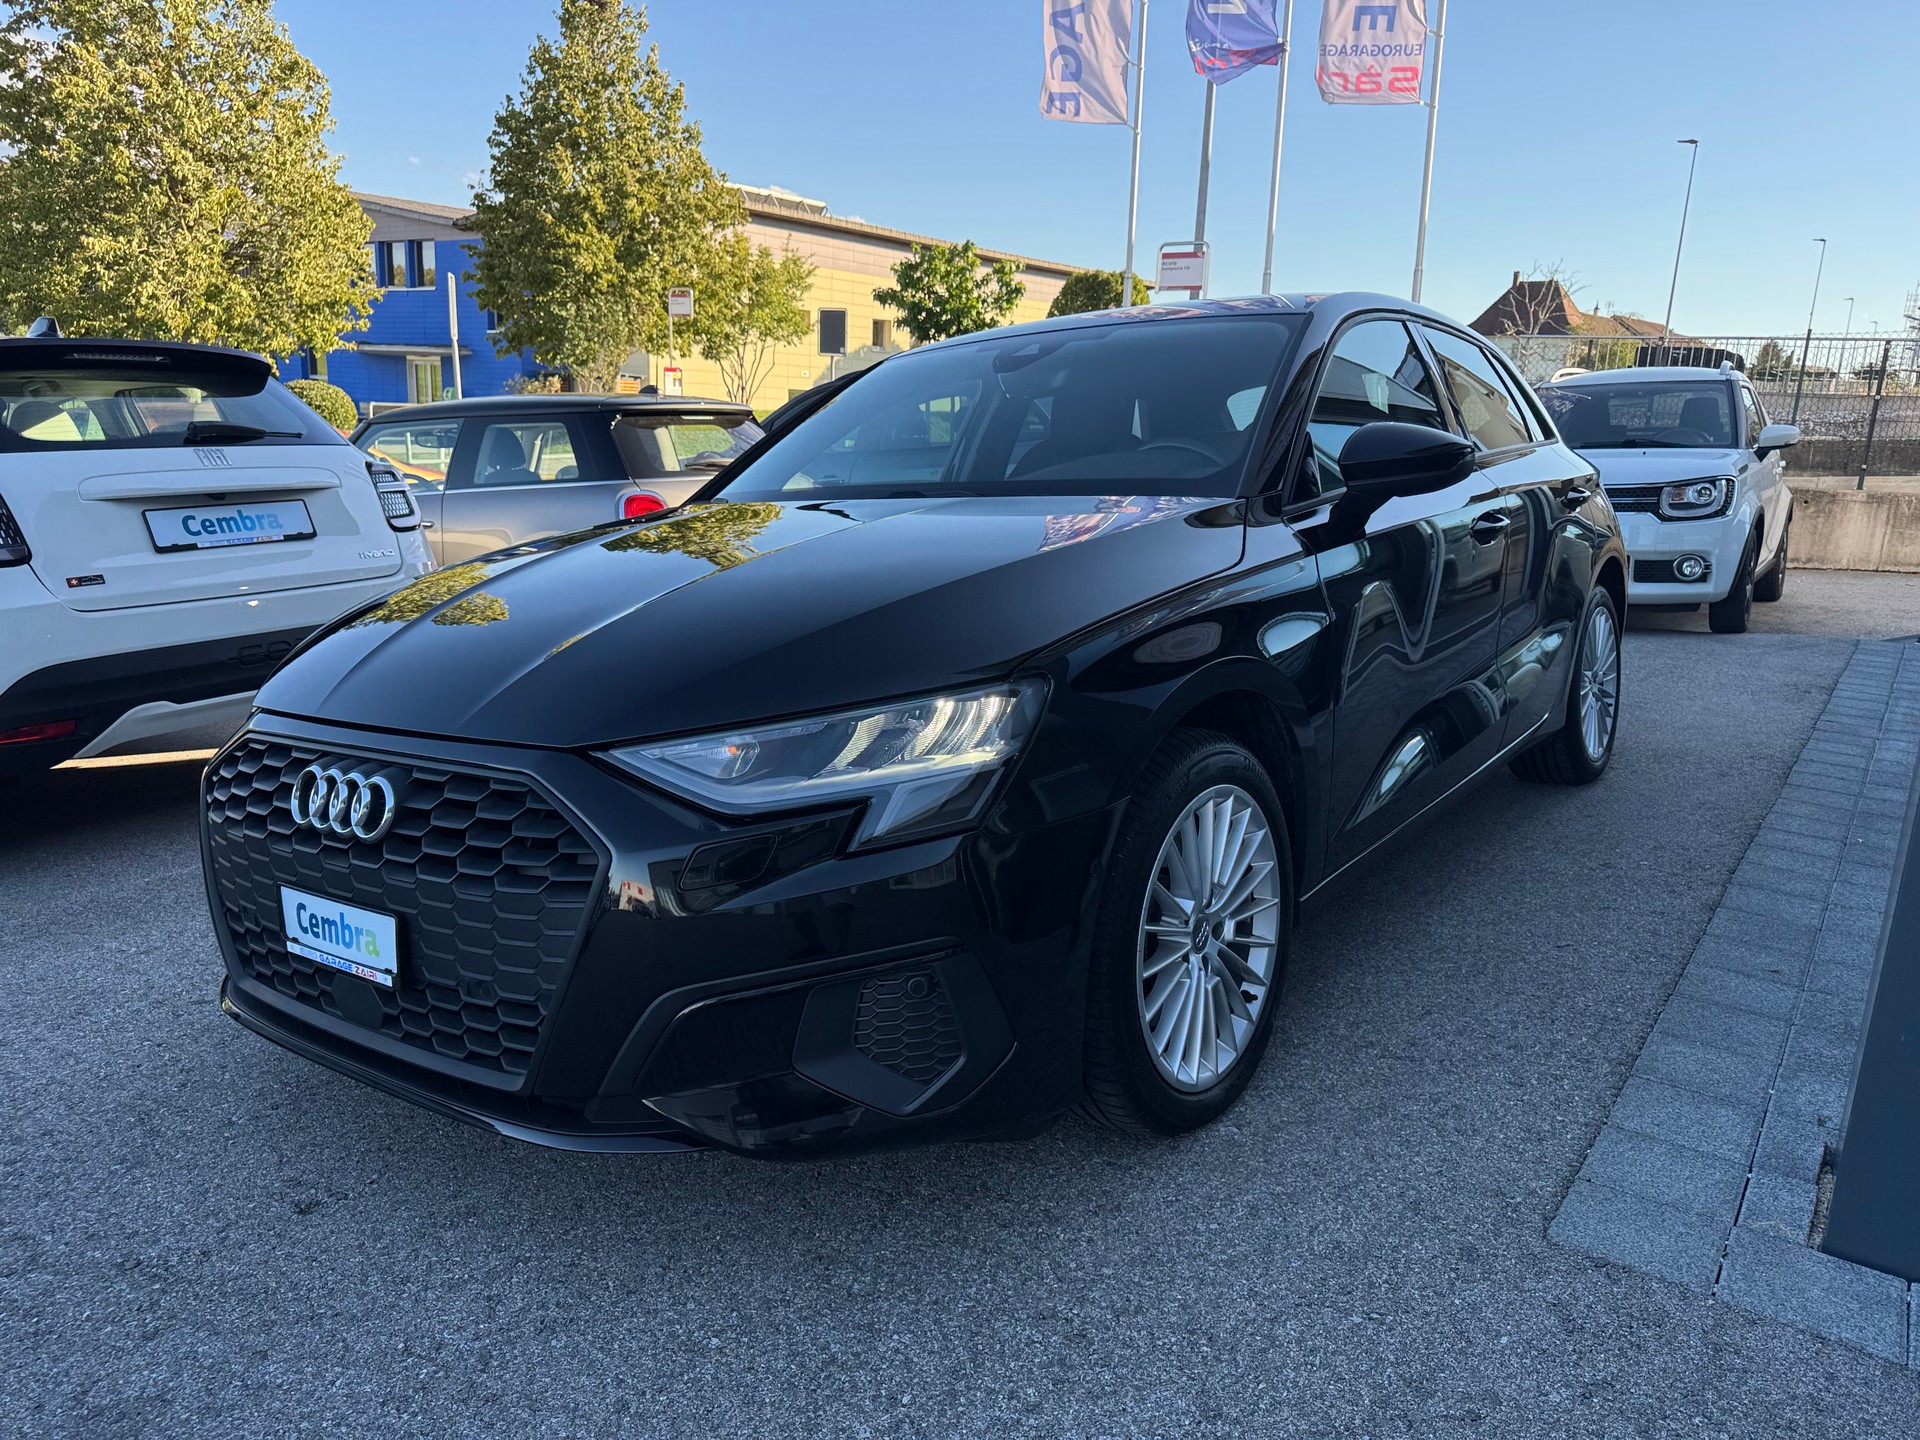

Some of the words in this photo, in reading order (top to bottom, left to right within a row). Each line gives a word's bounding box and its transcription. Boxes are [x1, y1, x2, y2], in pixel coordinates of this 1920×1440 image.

[192, 448, 233, 467] FIAT
[181, 509, 284, 537] Cembra
[296, 902, 381, 958] Cembra
[319, 954, 354, 972] GARAGE
[354, 965, 378, 981] ZAIRI
